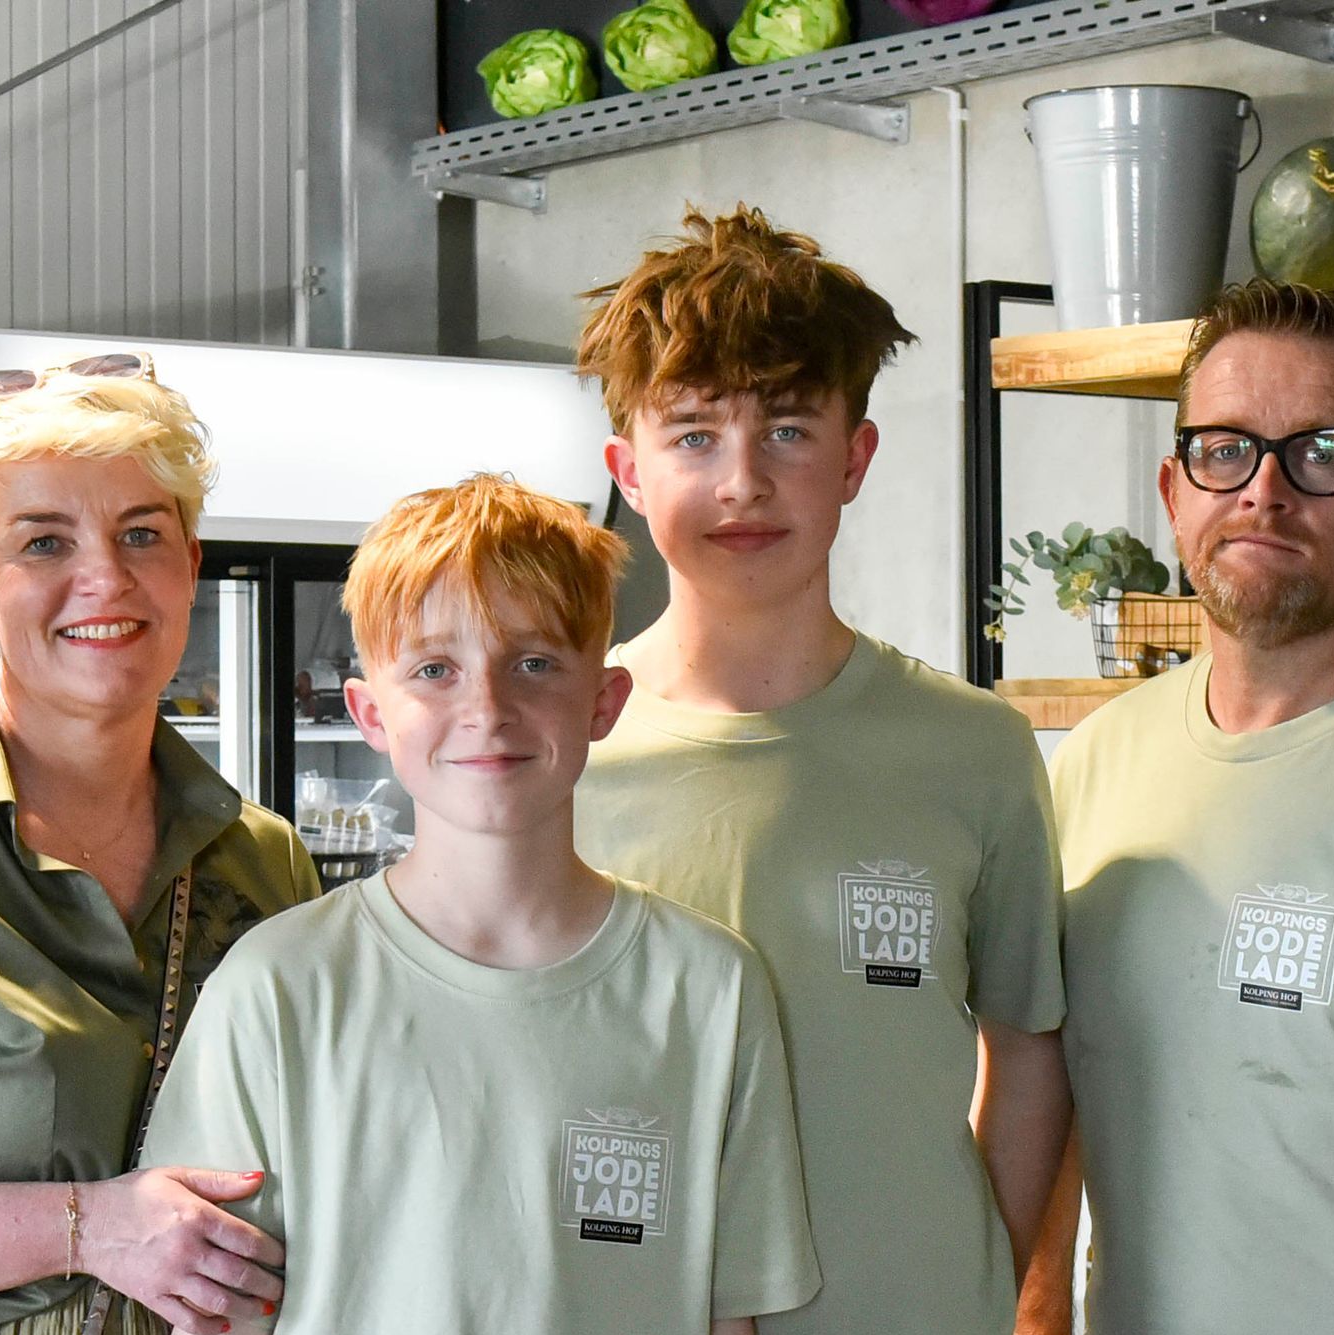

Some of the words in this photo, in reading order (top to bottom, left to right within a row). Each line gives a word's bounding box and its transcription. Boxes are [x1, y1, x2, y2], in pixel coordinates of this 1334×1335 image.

[852, 886, 933, 907] KOLPINGS
[853, 903, 934, 936] JODE
[1241, 906, 1327, 933] KOLPINGS
[858, 932, 931, 964] LADE
[1235, 923, 1325, 961] JODE
[1235, 951, 1320, 989] LADE
[1244, 986, 1279, 1000] KOLPING
[1280, 992, 1299, 1002] HOF
[575, 1134, 661, 1160] KOLPINGS
[573, 1153, 661, 1190] JODE
[574, 1185, 659, 1220] LADE
[584, 1222, 621, 1234] KOLPING
[622, 1226, 641, 1236] HOF
